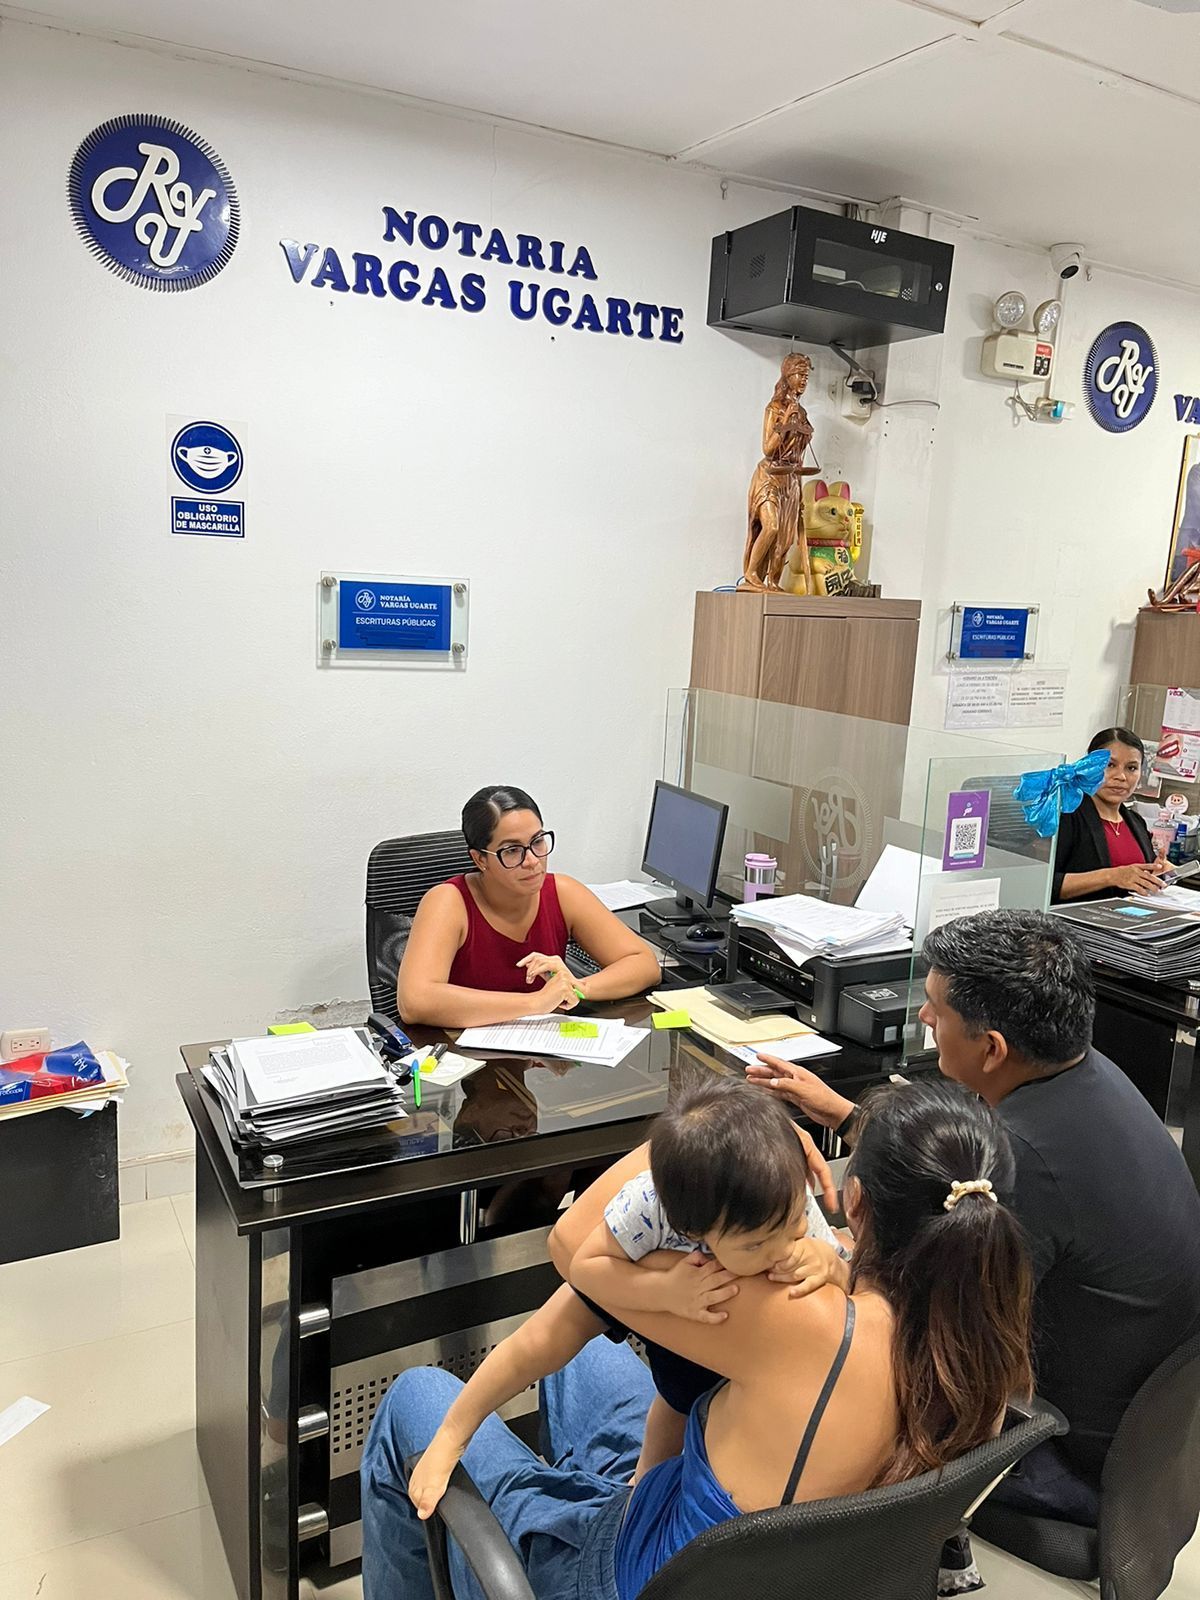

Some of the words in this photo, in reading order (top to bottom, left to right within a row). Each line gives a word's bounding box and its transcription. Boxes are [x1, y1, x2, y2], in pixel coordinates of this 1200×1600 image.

[870, 229, 888, 244] HJE
[381, 206, 599, 281] NOTARIA
[278, 239, 486, 313] VARGAS
[508, 279, 685, 344] UGARTE
[198, 503, 218, 513] USO
[177, 511, 239, 523] OBLIGATORIO
[176, 520, 188, 529] DE
[189, 521, 240, 532] MASCARILLA
[380, 601, 409, 609] VARGAS
[409, 602, 438, 610] UGARTE
[355, 617, 401, 626] ESCRITURAS
[402, 617, 437, 627] PÚBLICAS
